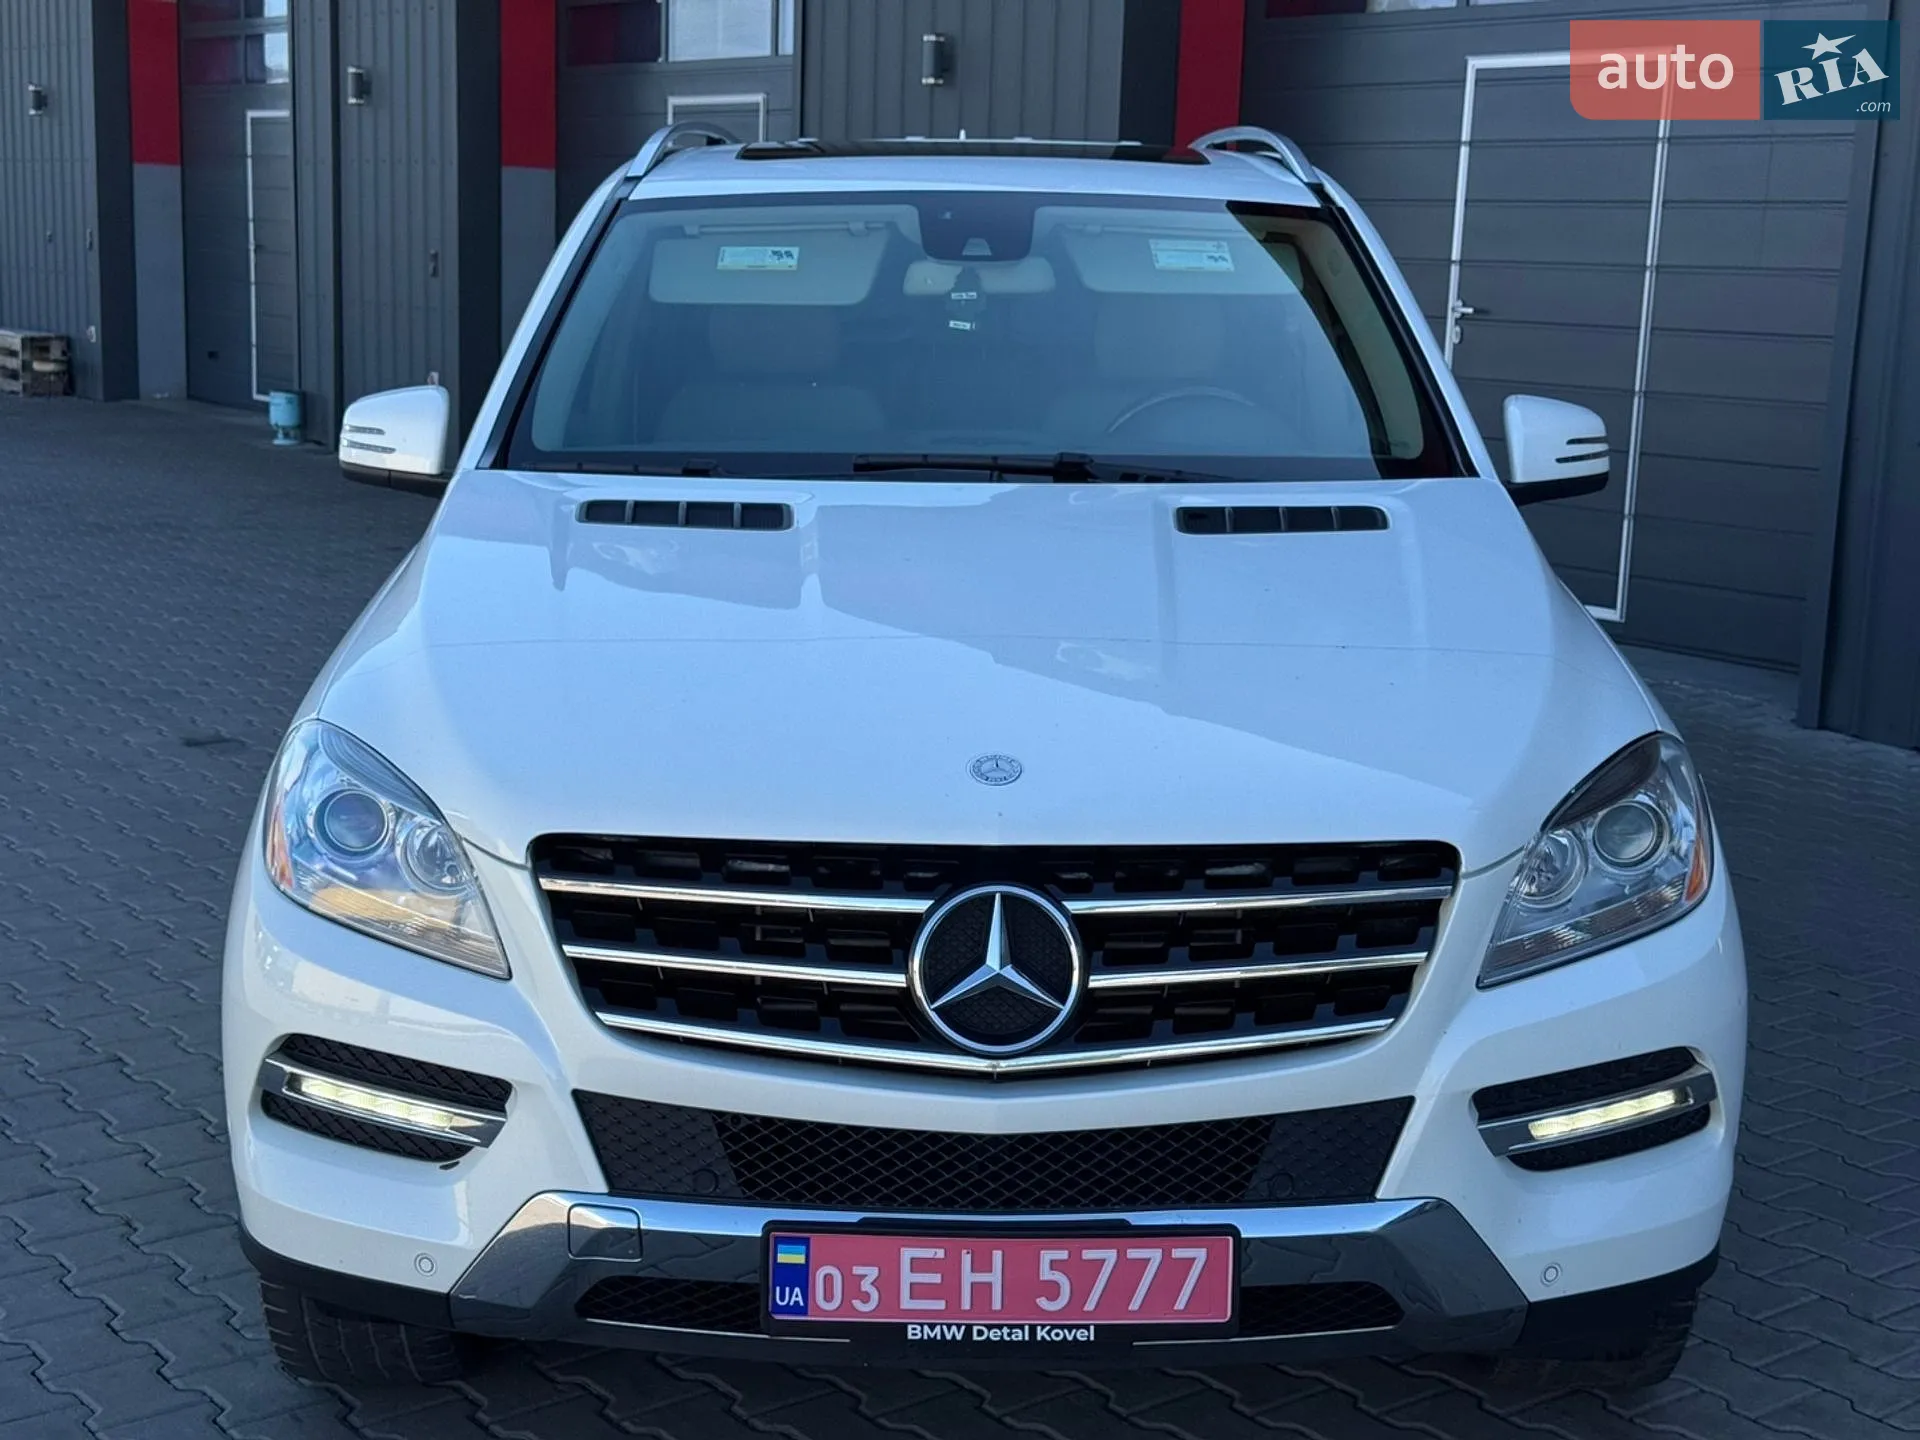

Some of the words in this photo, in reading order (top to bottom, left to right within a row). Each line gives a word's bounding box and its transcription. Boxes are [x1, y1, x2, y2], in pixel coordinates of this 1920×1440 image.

[815, 1265, 879, 1312] 03
[900, 1247, 1004, 1311] EH
[1035, 1248, 1208, 1312] 5777
[776, 1286, 804, 1307] UA
[906, 1324, 966, 1341] BMW
[972, 1324, 1030, 1341] Detal
[1037, 1325, 1095, 1342] Kovel
